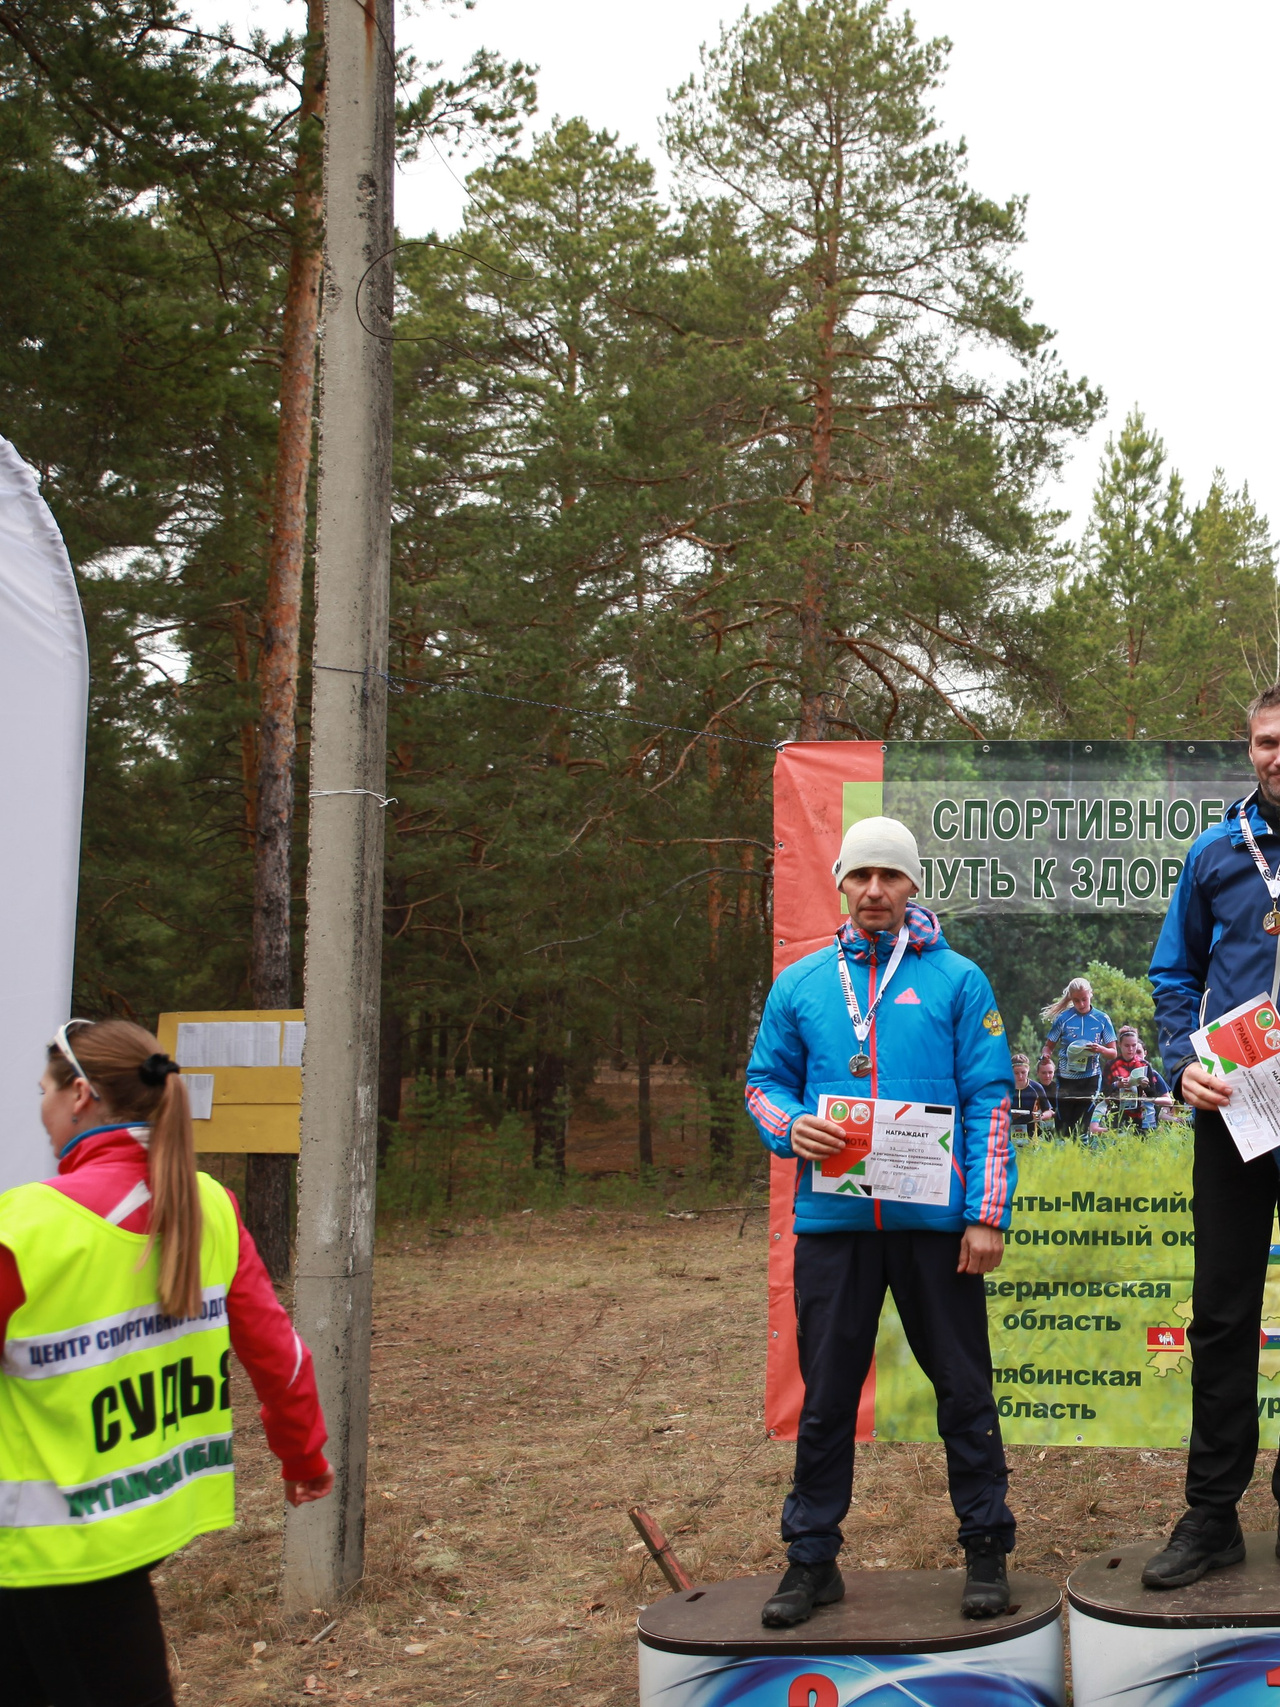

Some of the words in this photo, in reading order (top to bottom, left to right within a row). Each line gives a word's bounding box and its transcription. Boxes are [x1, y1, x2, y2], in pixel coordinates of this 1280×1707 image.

[932, 799, 1224, 841] СПОРТИВНОЕ
[1033, 857, 1057, 899] К
[1233, 1021, 1257, 1062] ГРАМОТА
[885, 1129, 928, 1138] НАГРАЖДАЕТ
[1003, 1309, 1121, 1331] область
[29, 1334, 91, 1367] ЦЕНТР
